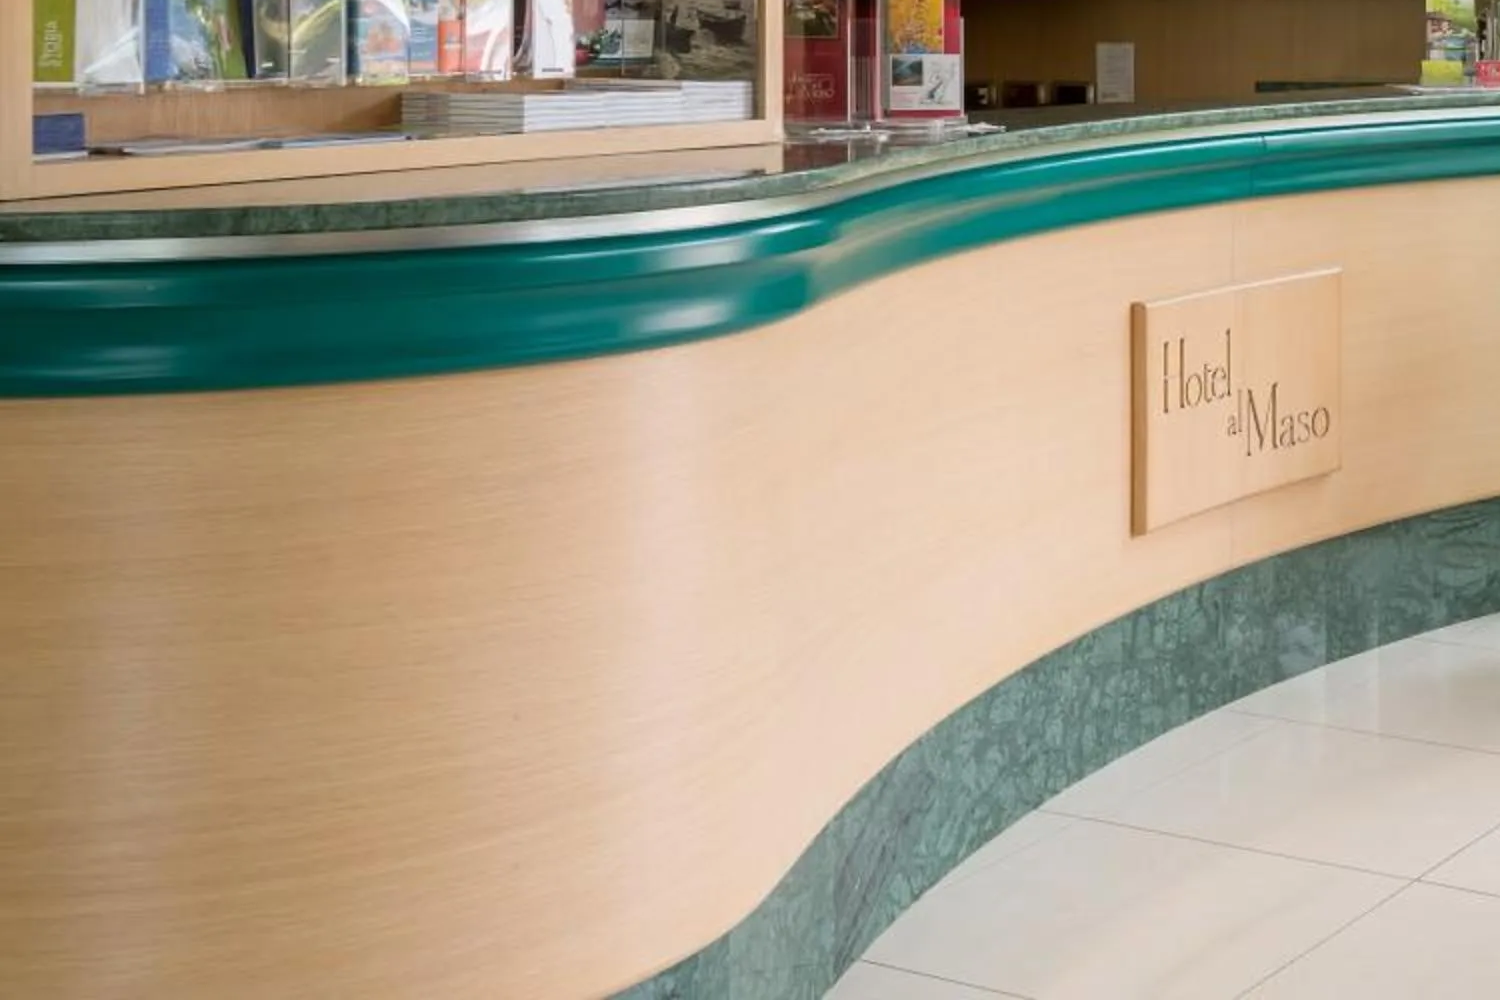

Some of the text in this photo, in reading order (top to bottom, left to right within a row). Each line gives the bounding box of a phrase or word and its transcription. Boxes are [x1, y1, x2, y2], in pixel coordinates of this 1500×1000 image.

[1162, 327, 1231, 414] Hotel
[1227, 381, 1330, 457] al Maso
